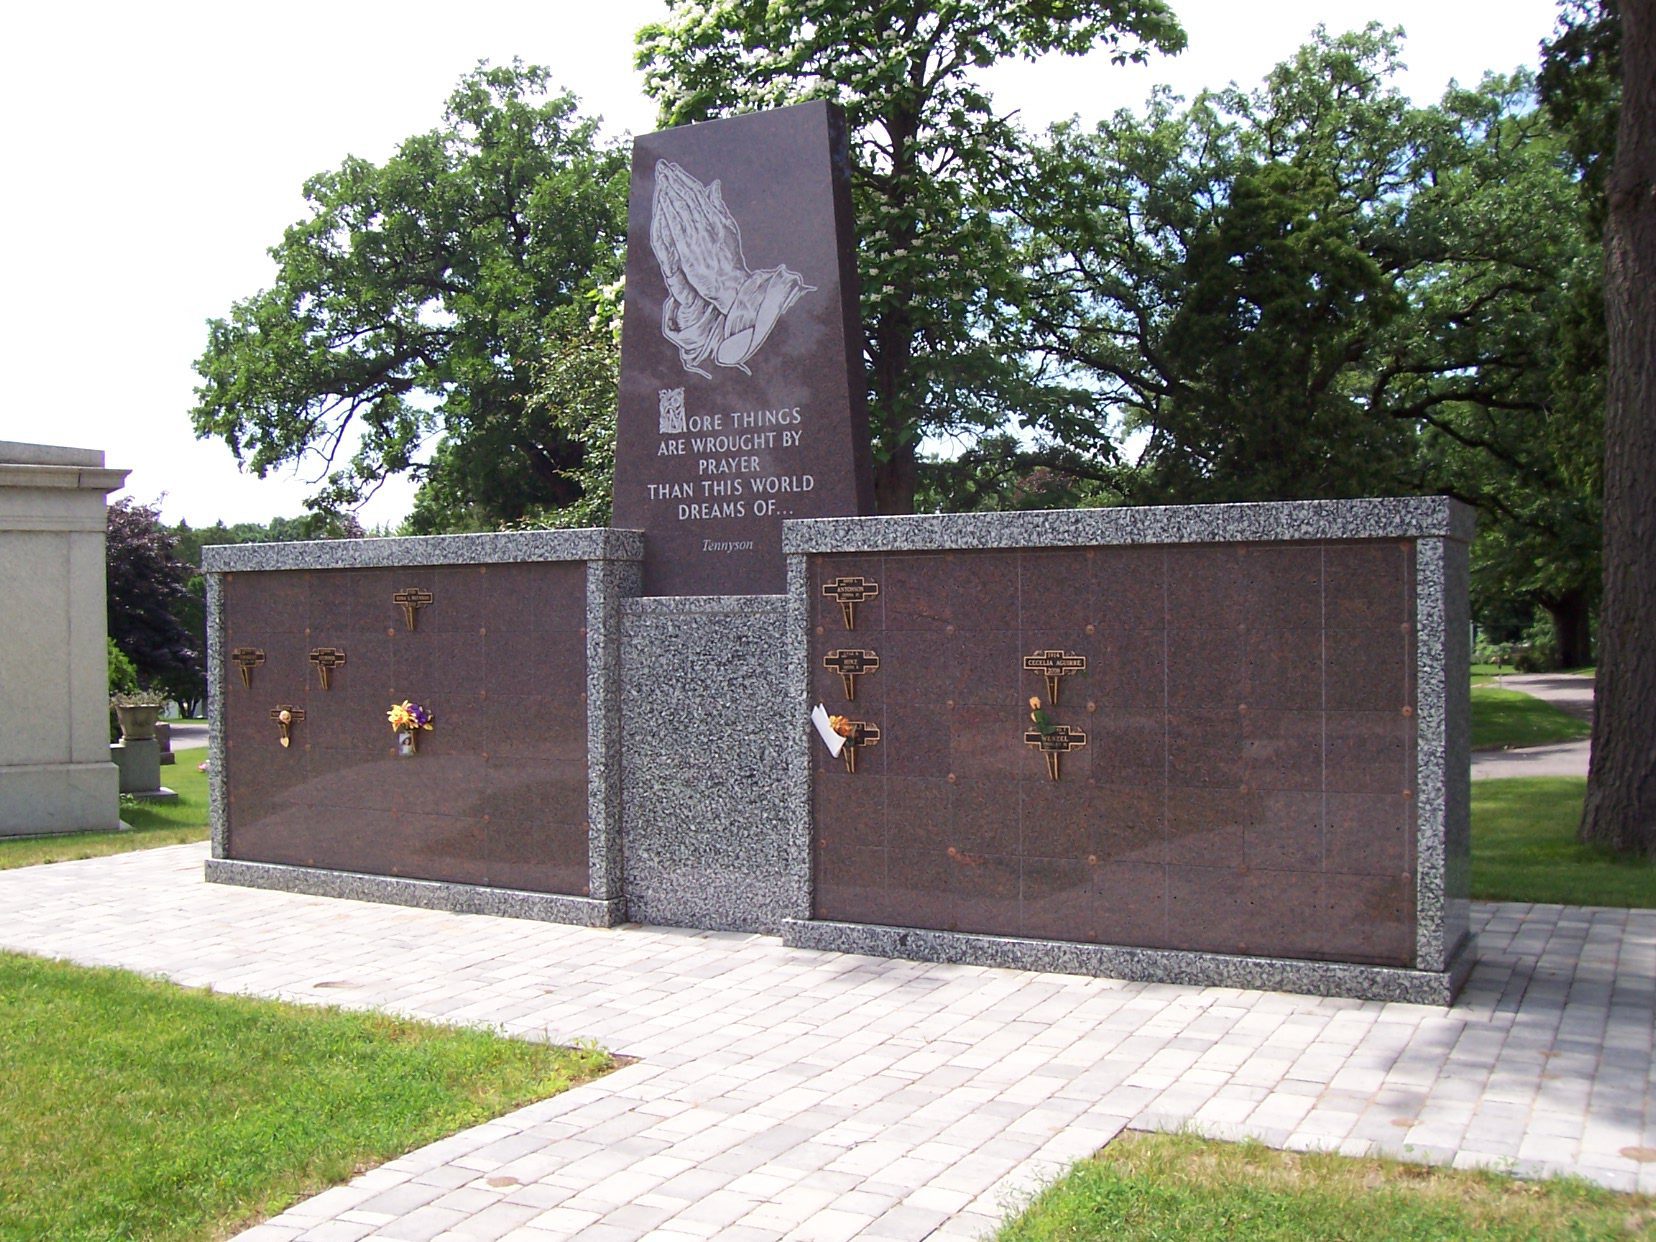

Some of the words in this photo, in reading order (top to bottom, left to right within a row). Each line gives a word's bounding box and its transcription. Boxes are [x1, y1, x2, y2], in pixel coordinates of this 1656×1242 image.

[658, 387, 723, 434] MORE
[730, 407, 802, 429] THINGS
[657, 439, 686, 456] ARE
[691, 432, 777, 453] WROUGHT
[782, 430, 803, 447] BY
[699, 456, 760, 475] PRAYER
[647, 482, 694, 500] THAN
[701, 479, 743, 497] THIS
[751, 475, 814, 494] WORLD
[678, 501, 745, 520] DREAMS
[753, 500, 794, 516] OF...
[702, 539, 754, 554] Tennyson
